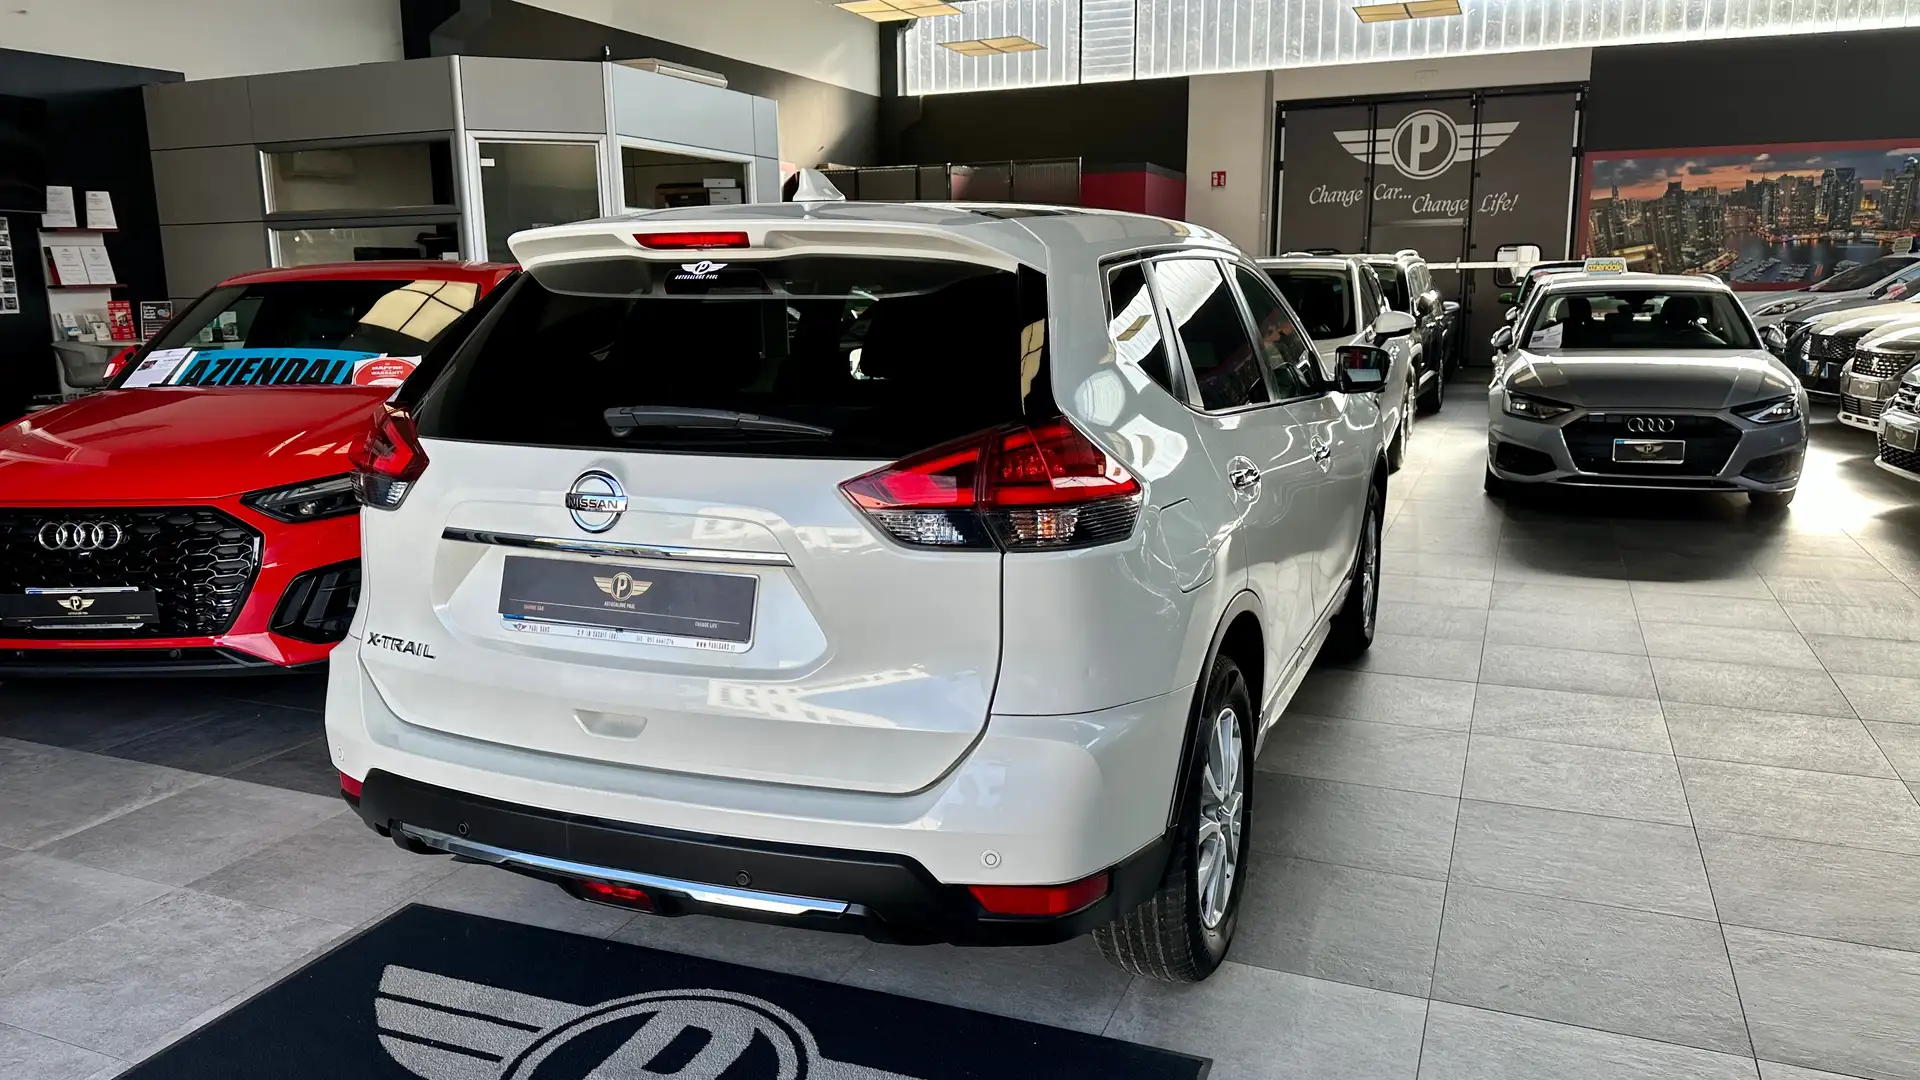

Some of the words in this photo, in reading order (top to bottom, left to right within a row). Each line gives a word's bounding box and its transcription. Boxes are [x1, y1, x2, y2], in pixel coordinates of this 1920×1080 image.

[1309, 184, 1363, 207] Change
[1373, 183, 1412, 200] Car...
[1412, 193, 1469, 216] Change
[1478, 192, 1519, 216] Life!
[183, 357, 353, 386] AZIENDAL
[569, 497, 618, 510] NISSAN
[367, 632, 436, 659] X-TRAIL
